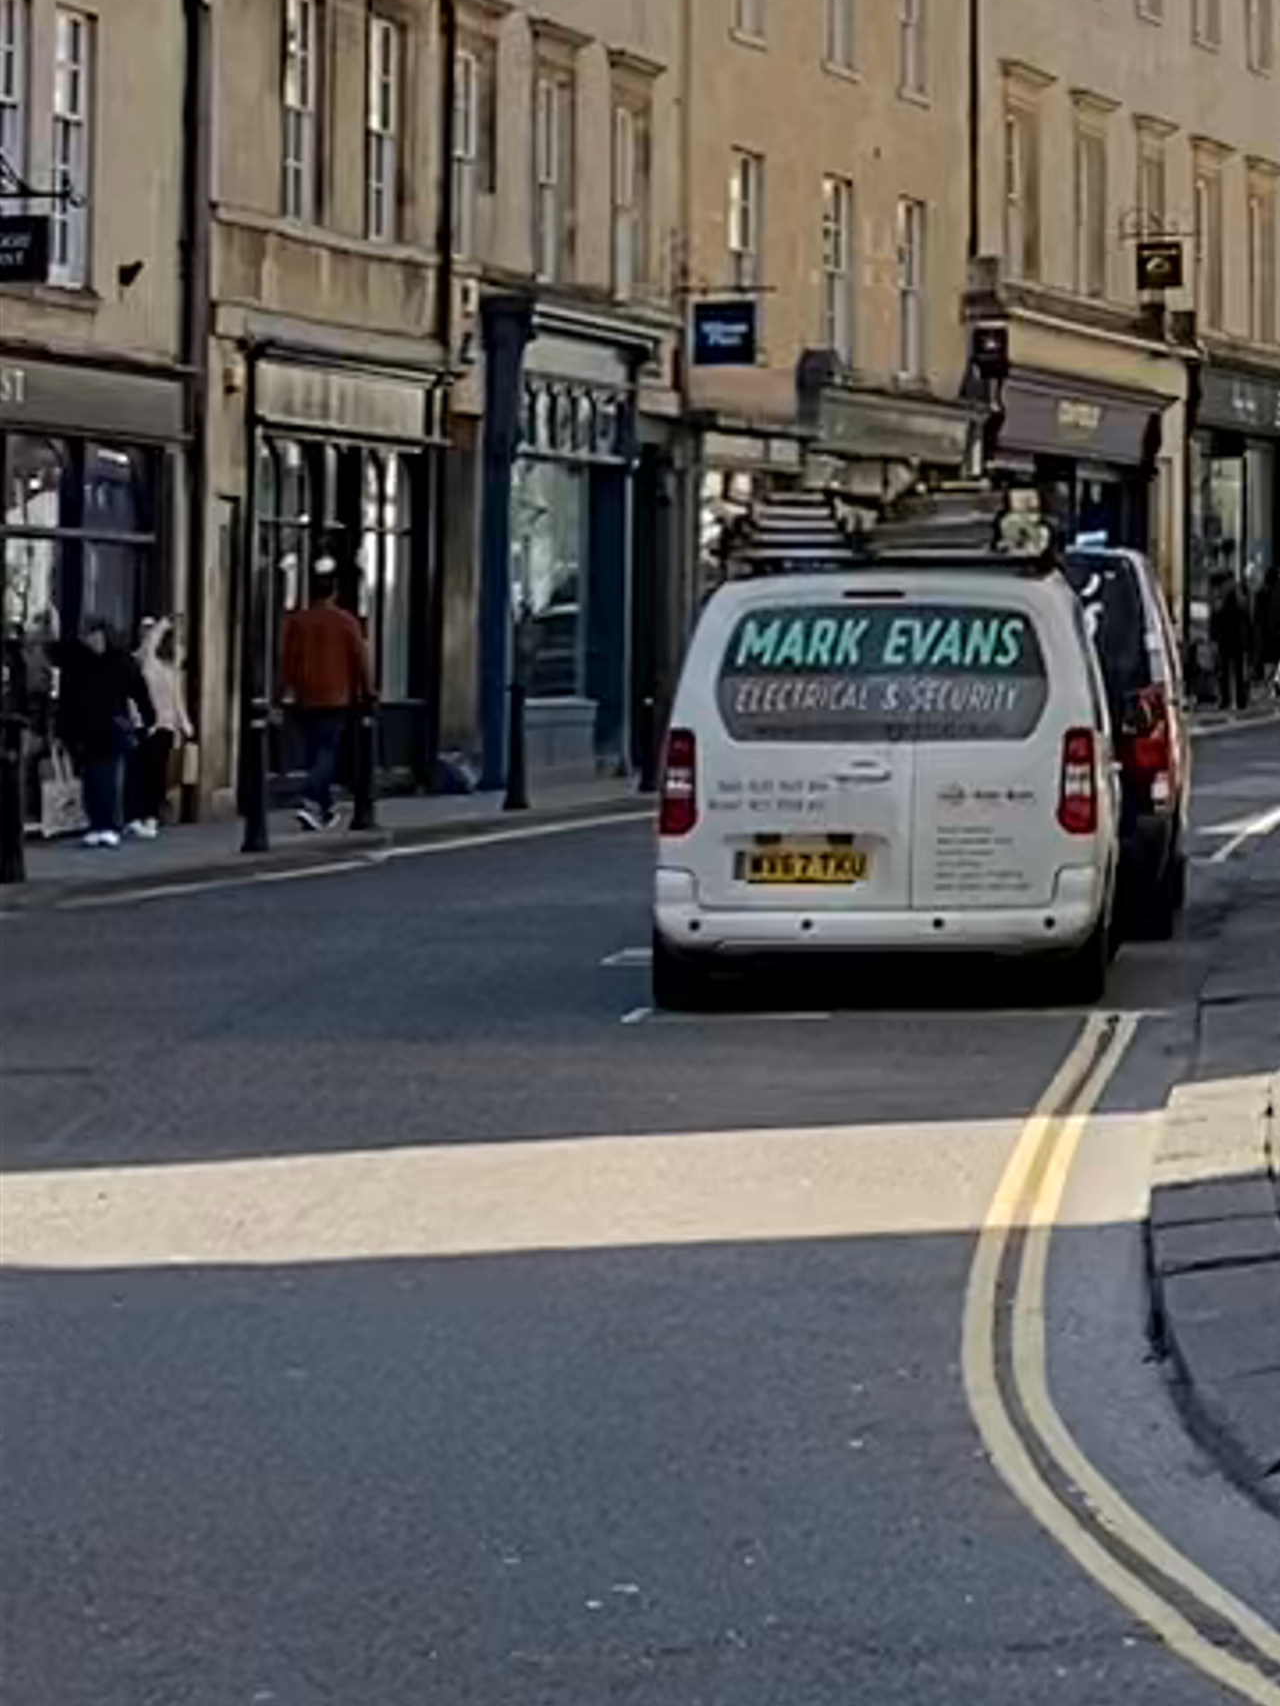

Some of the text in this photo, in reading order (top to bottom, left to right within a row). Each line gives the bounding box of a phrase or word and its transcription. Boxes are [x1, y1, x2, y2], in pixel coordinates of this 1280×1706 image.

[735, 617, 1024, 666] MARK EVANS
[735, 682, 868, 714] ELECTRICAL
[908, 679, 1020, 712] SECURITY
